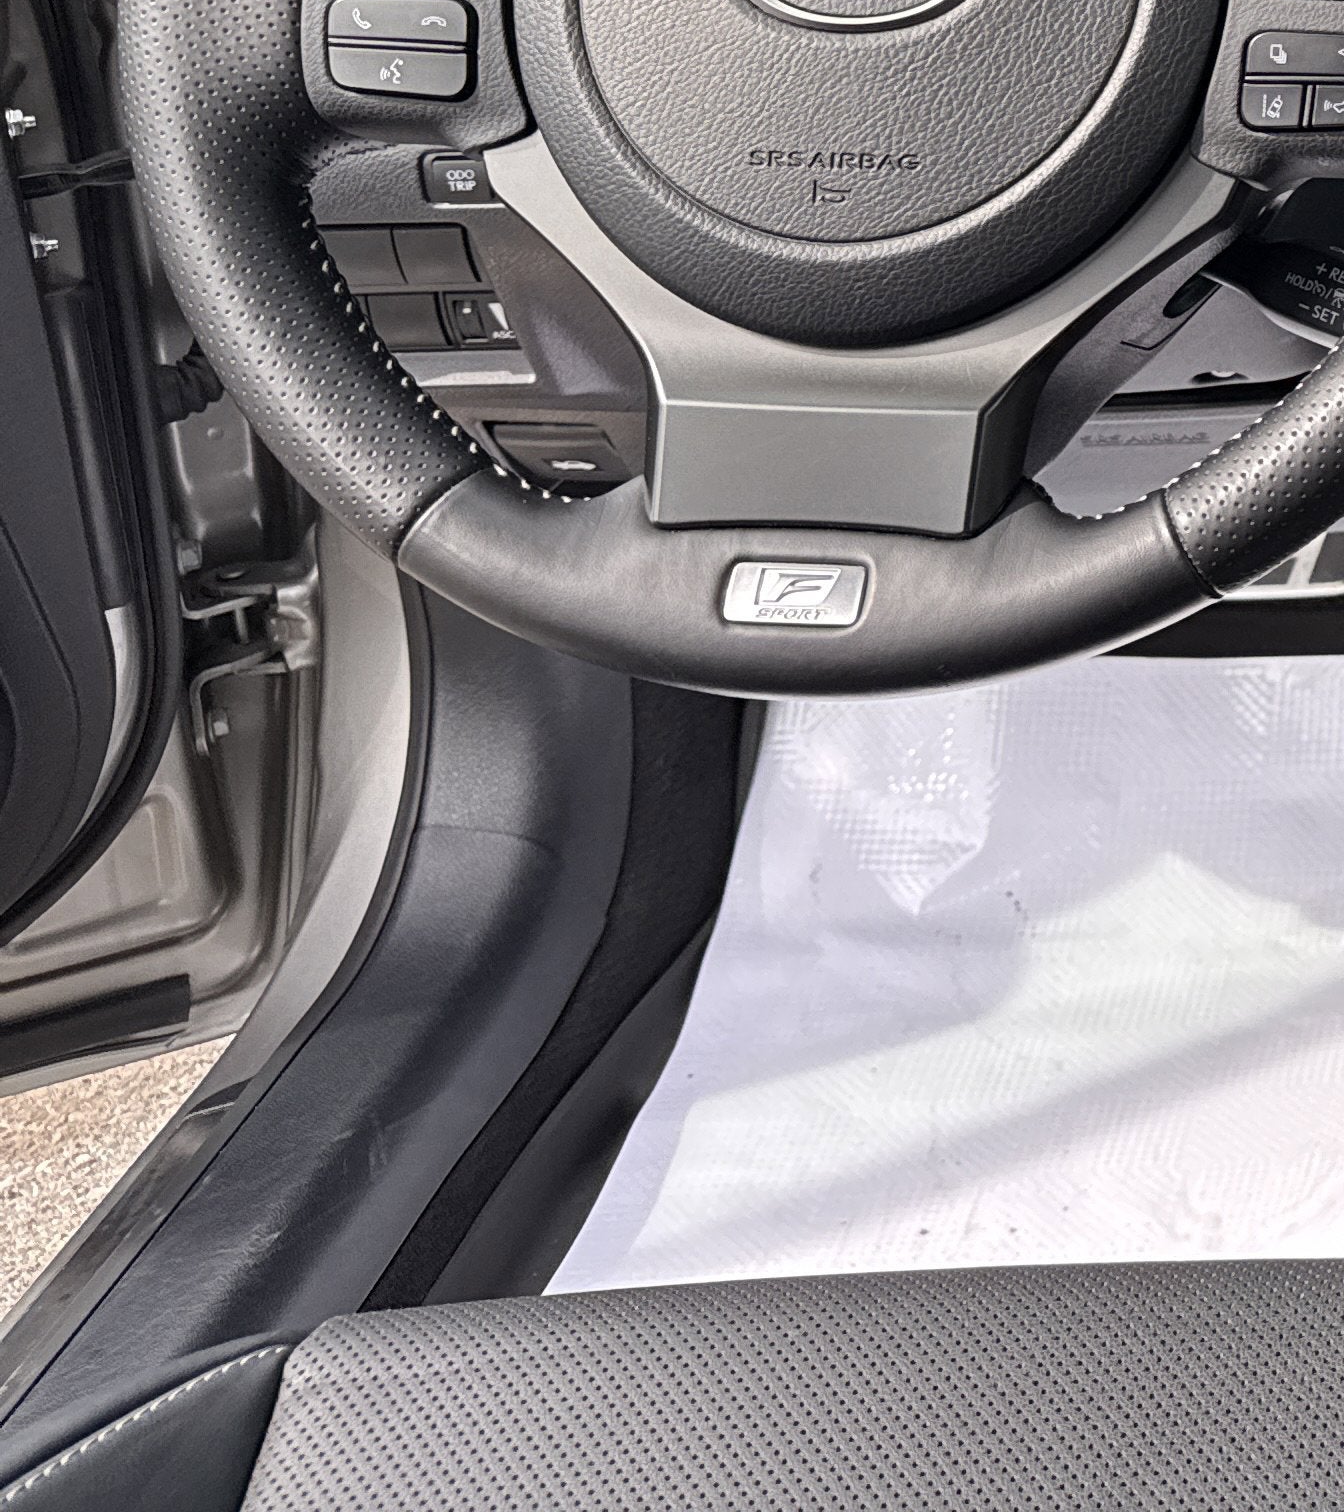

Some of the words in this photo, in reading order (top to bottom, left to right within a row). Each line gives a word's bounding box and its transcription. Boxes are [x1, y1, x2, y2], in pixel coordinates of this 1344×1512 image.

[748, 149, 803, 168] SRS
[807, 151, 921, 171] AIRBAG
[446, 169, 476, 181] ODO
[447, 180, 477, 192] TRIP
[1284, 271, 1314, 294] HOLD
[1311, 305, 1340, 326] SET
[755, 607, 829, 621] SPORT
